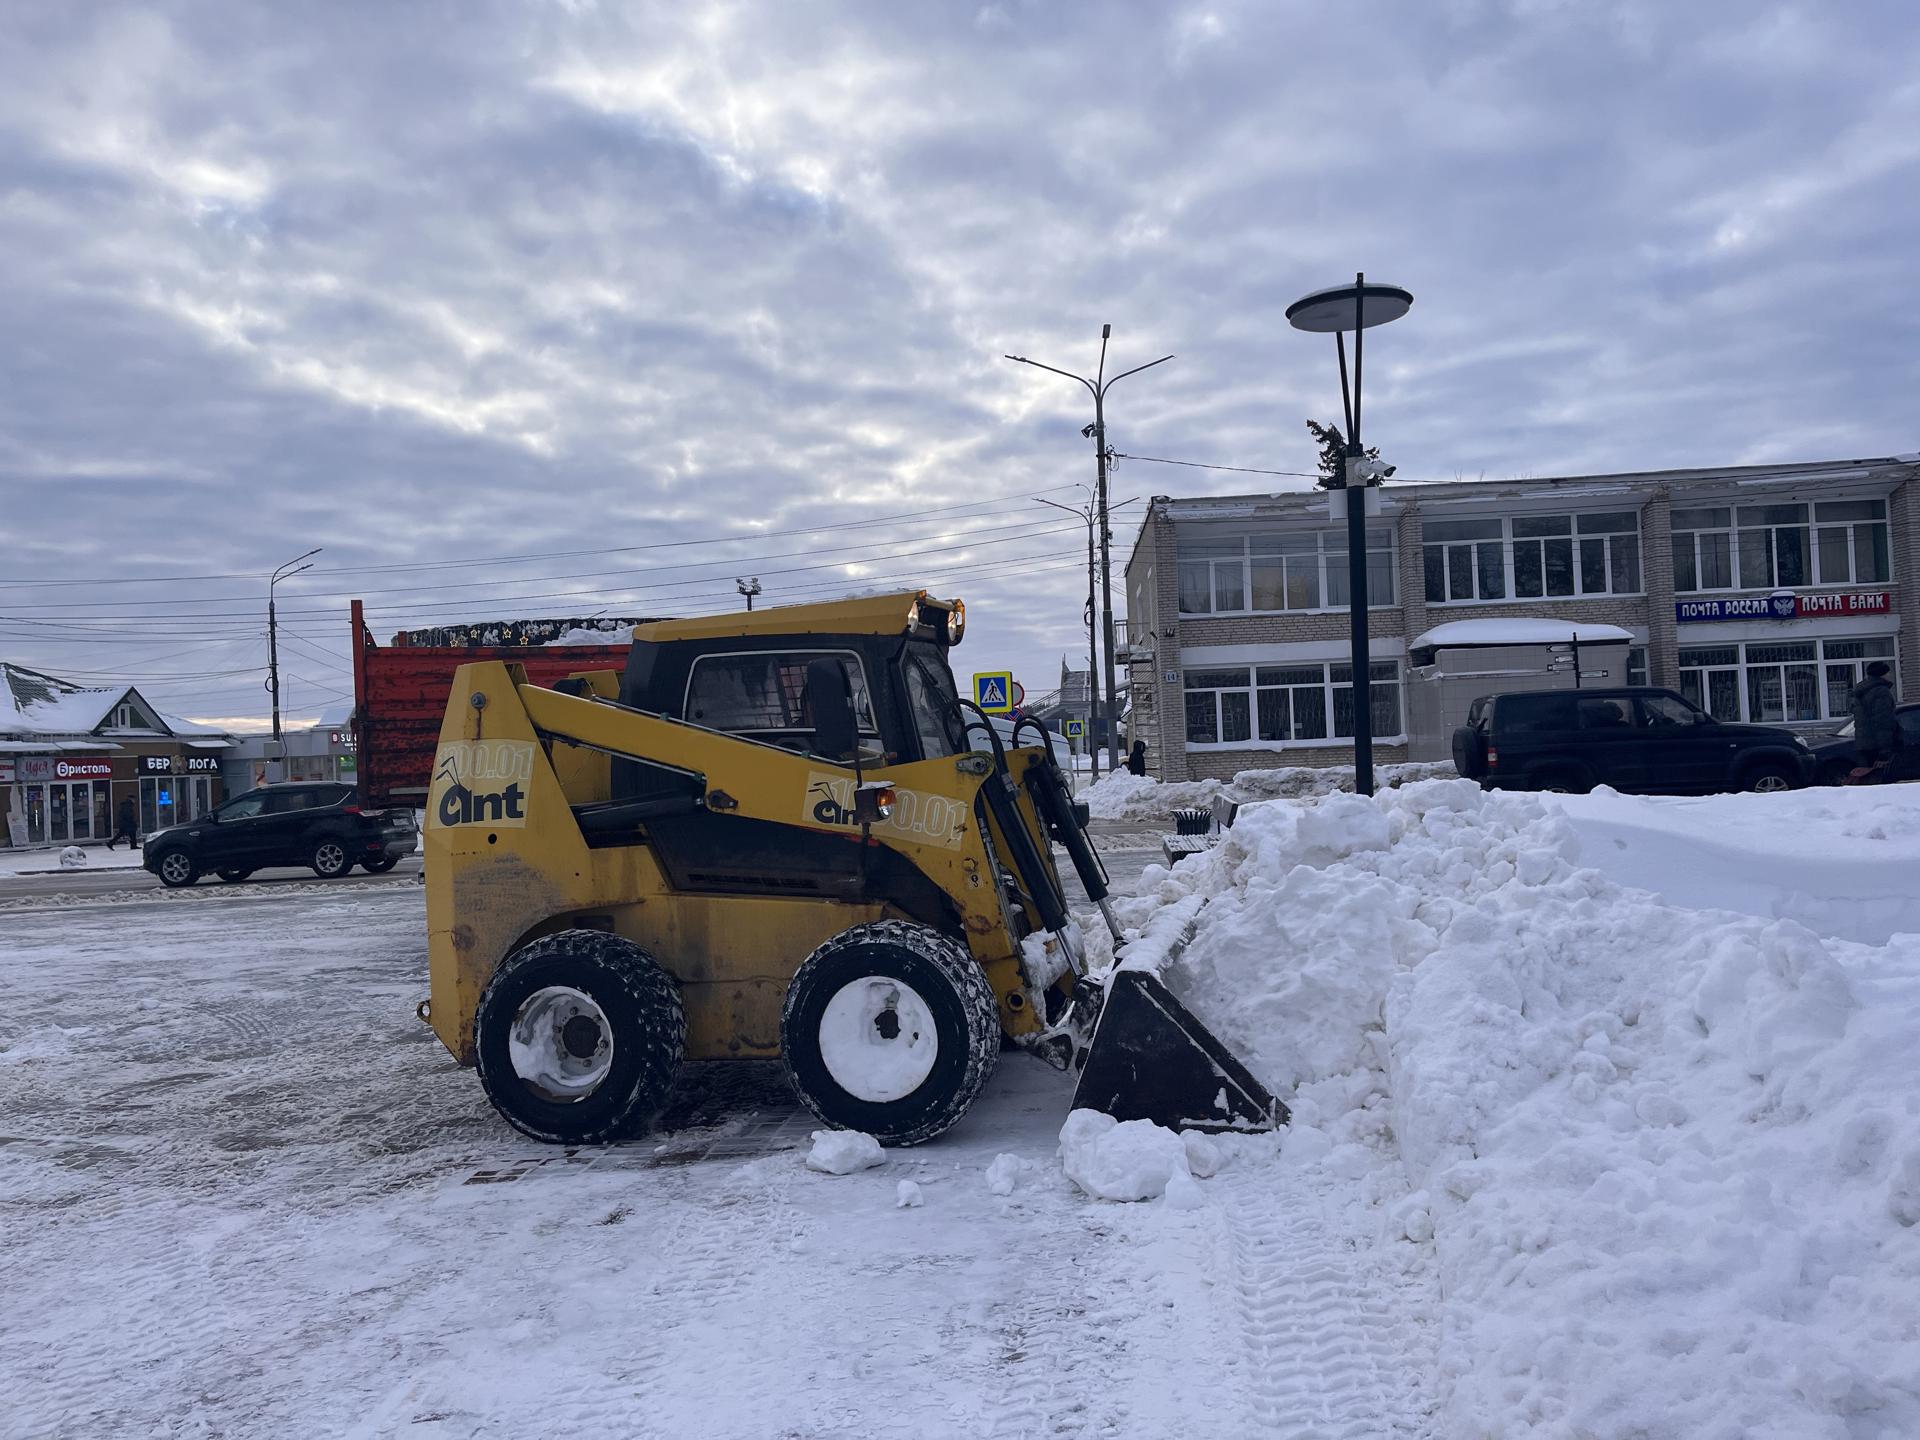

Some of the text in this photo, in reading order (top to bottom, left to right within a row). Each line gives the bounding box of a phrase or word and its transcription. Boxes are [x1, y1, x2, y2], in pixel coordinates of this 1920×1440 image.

[1682, 599, 1768, 617] ПОЧТА РОССИИ
[1802, 594, 1884, 612] ПОЧТА БАНК
[57, 761, 111, 777] Бристоль
[147, 757, 218, 770] БЕР ЛОГА
[812, 799, 861, 826] an
